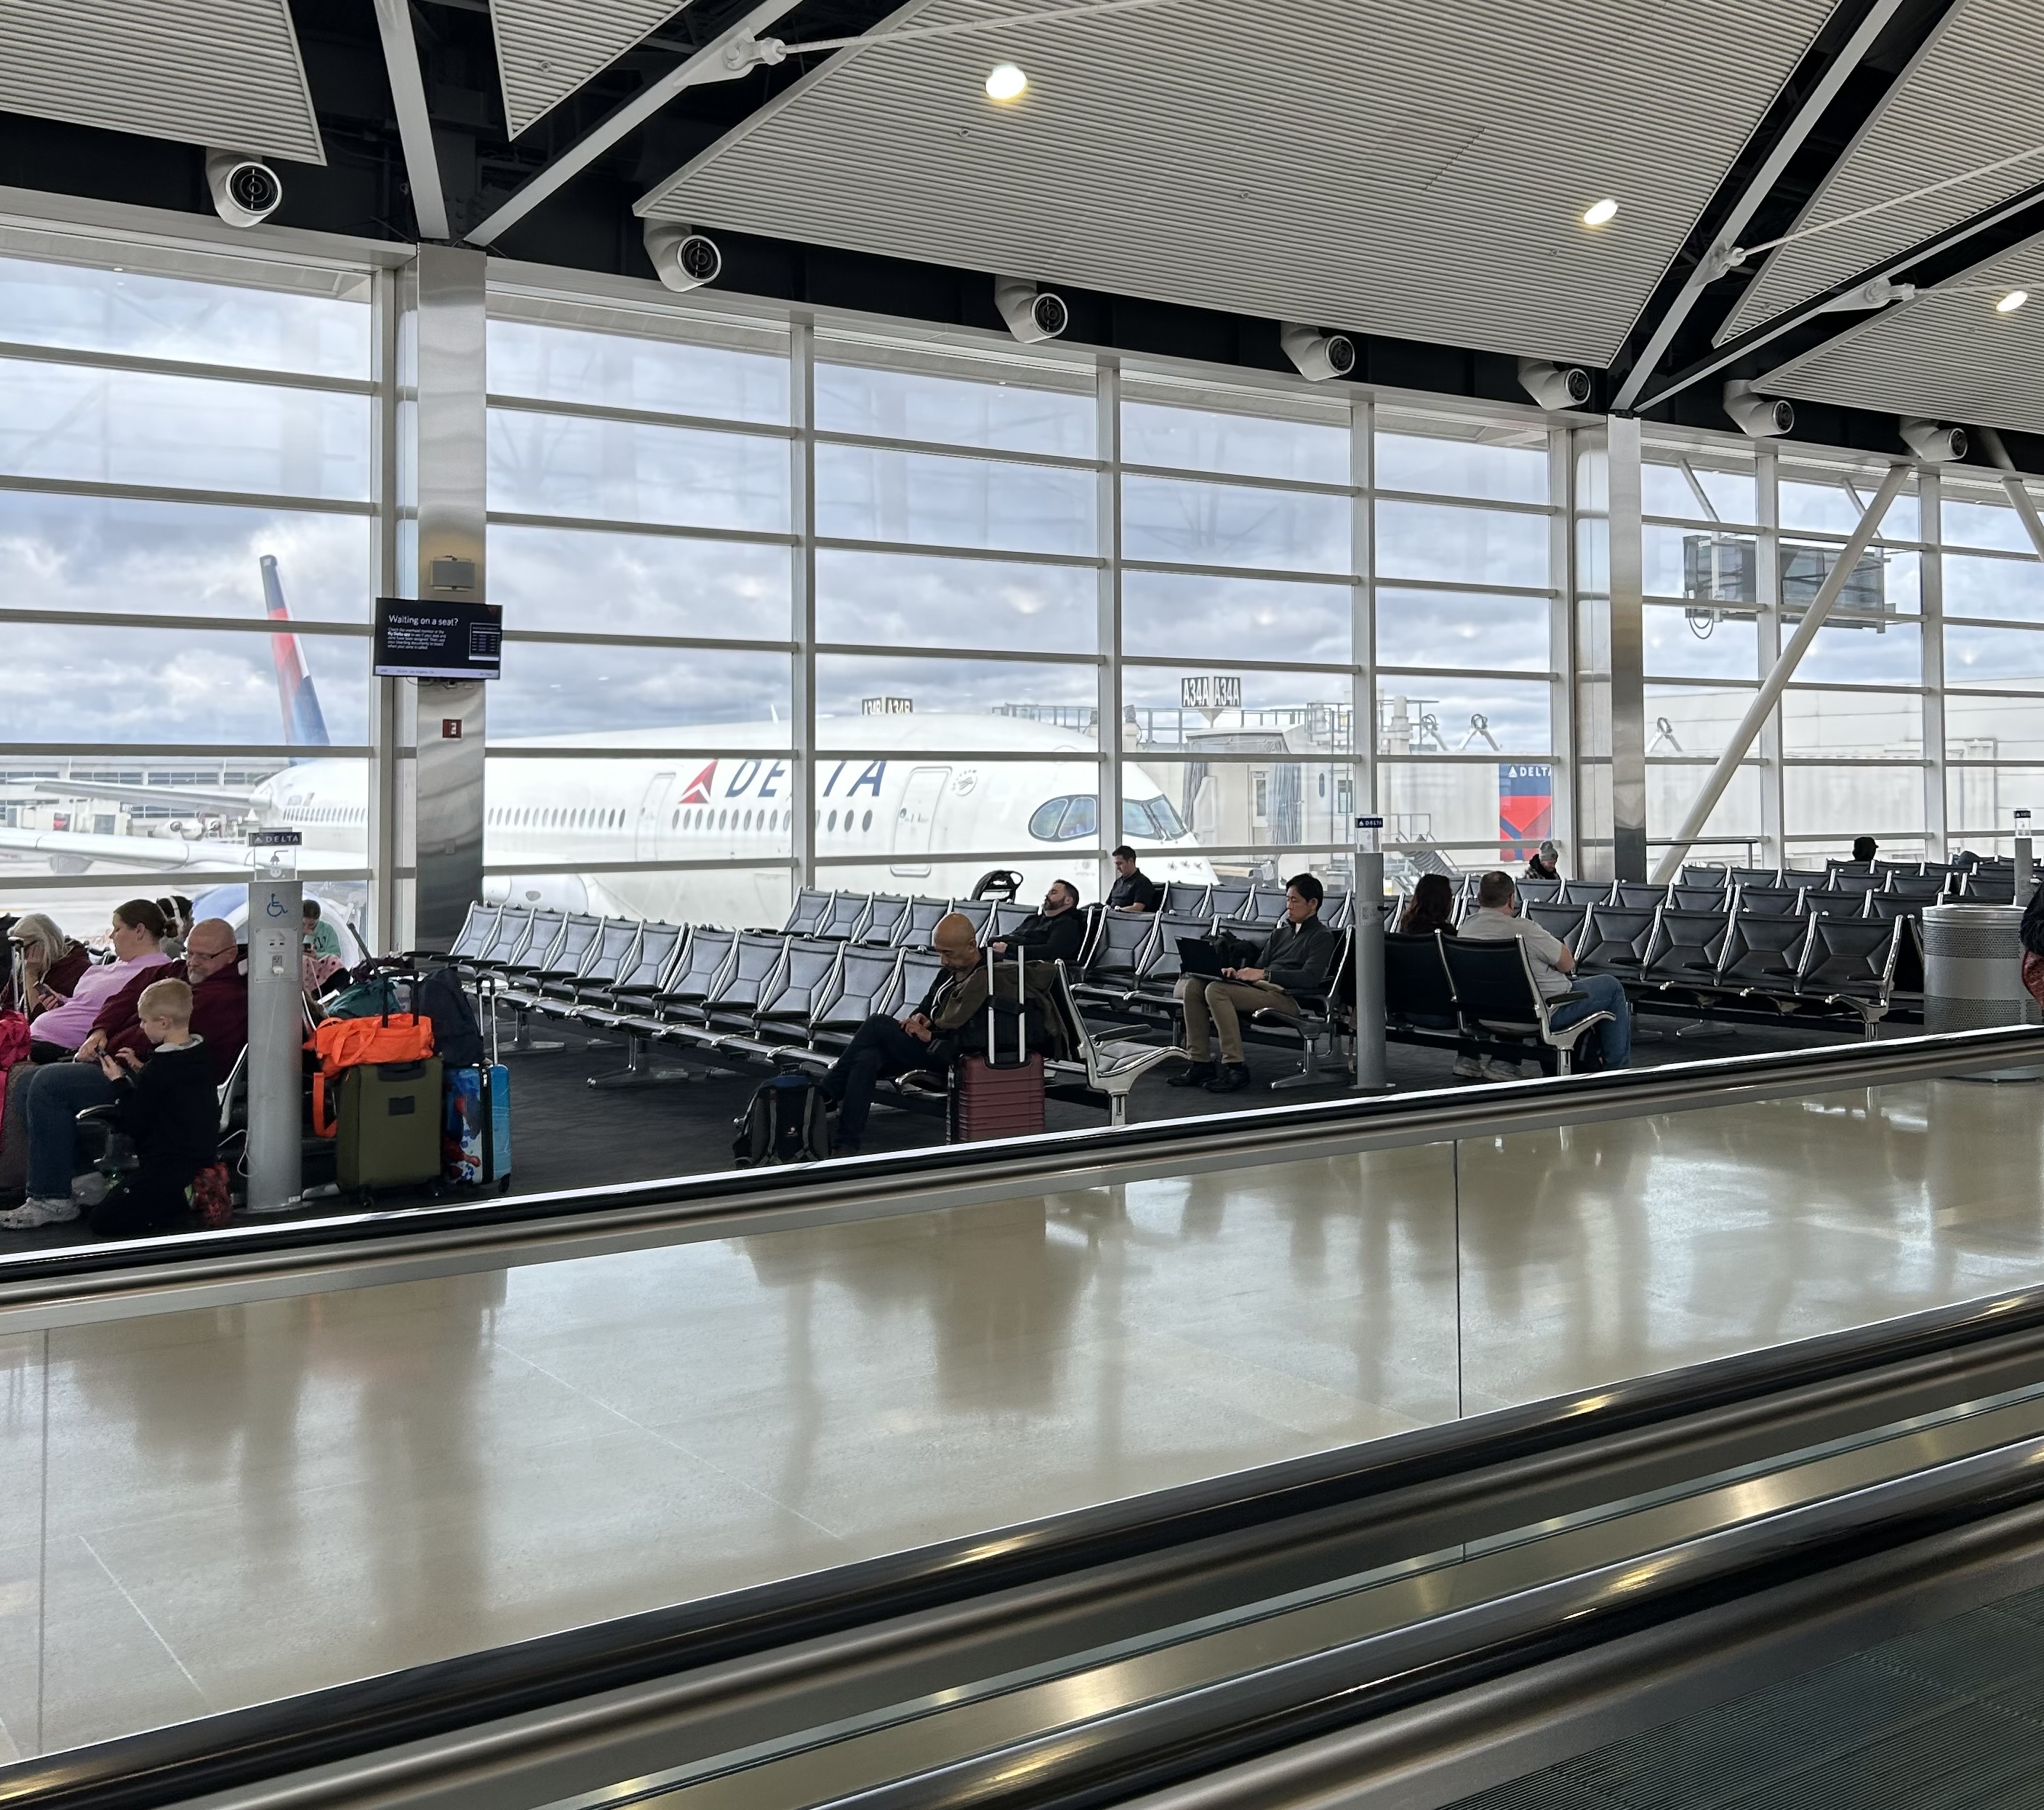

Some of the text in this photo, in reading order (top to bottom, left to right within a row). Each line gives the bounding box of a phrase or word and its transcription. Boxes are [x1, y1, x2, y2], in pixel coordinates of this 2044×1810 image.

[388, 614, 419, 625] Waiting
[438, 617, 459, 626] seat?
[1183, 677, 1209, 706] A34A
[1214, 677, 1240, 706] A34A
[725, 758, 887, 798] DETA
